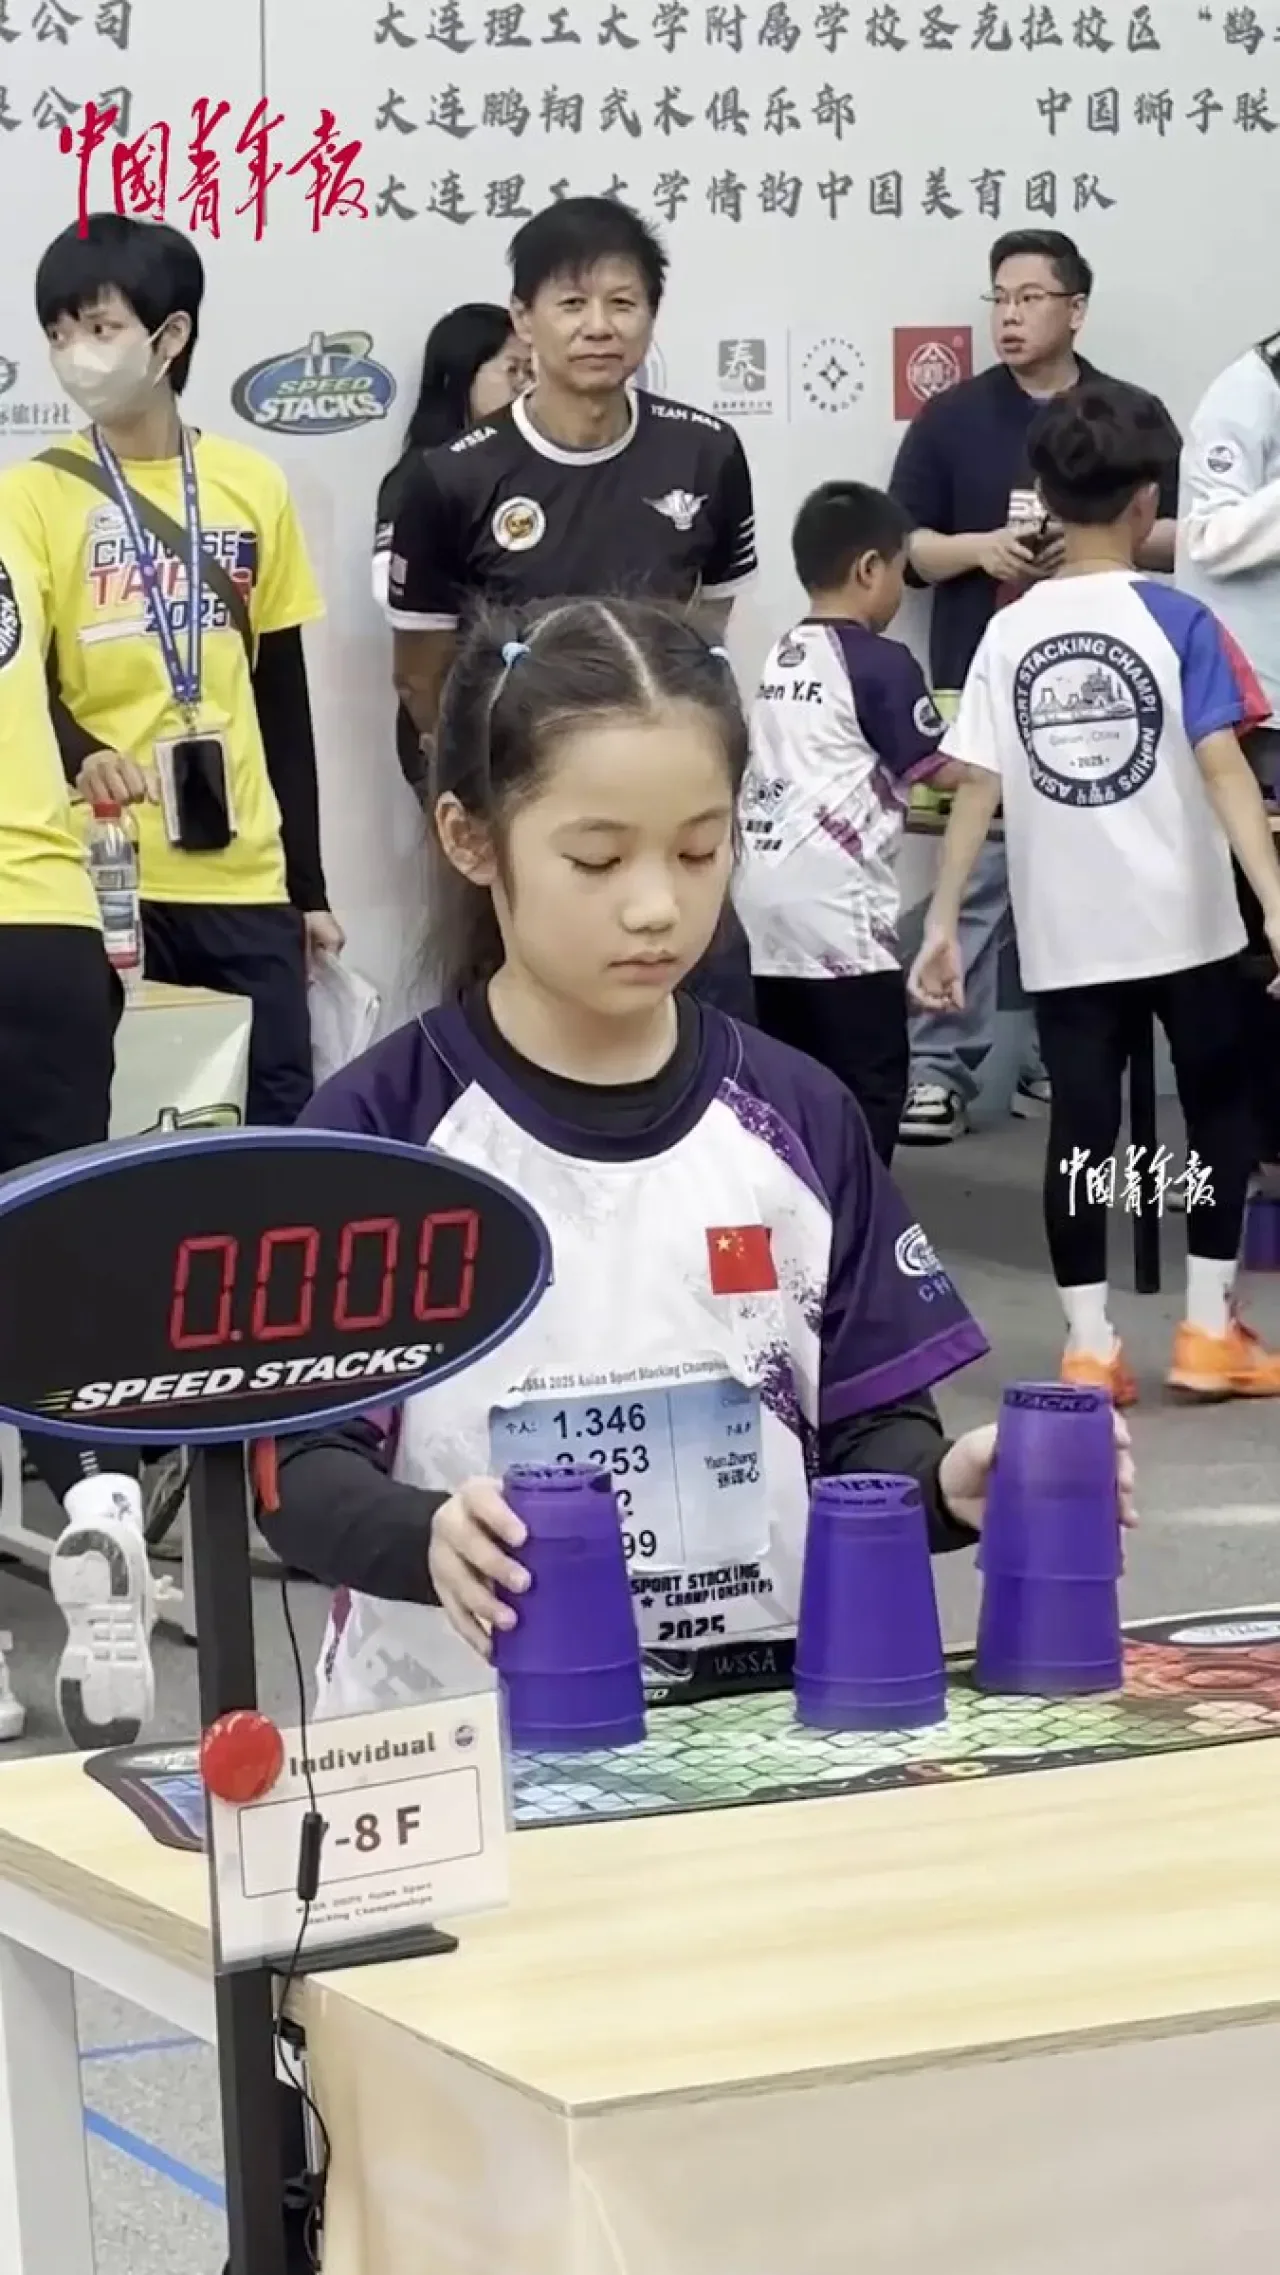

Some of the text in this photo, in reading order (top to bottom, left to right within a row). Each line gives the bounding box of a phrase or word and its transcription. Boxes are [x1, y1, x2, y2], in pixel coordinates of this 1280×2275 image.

[375, 83, 856, 139] 大连鹏翔武术俱乐部
[276, 376, 372, 396] SPEED
[254, 393, 386, 424] STACKS
[1018, 636, 1107, 685] STACKING
[169, 1209, 480, 1350] 0.000
[71, 1344, 432, 1412] SPEED STACKS
[553, 1402, 646, 1439] 1.346
[631, 1562, 761, 1595] SPORT STACKING
[665, 1577, 773, 1608] CHAMPIONSHIPS
[658, 1614, 725, 1641] 2025
[713, 1648, 777, 1676] WSSA
[289, 1731, 437, 1777] Individual
[321, 1804, 422, 1853] -8 F
